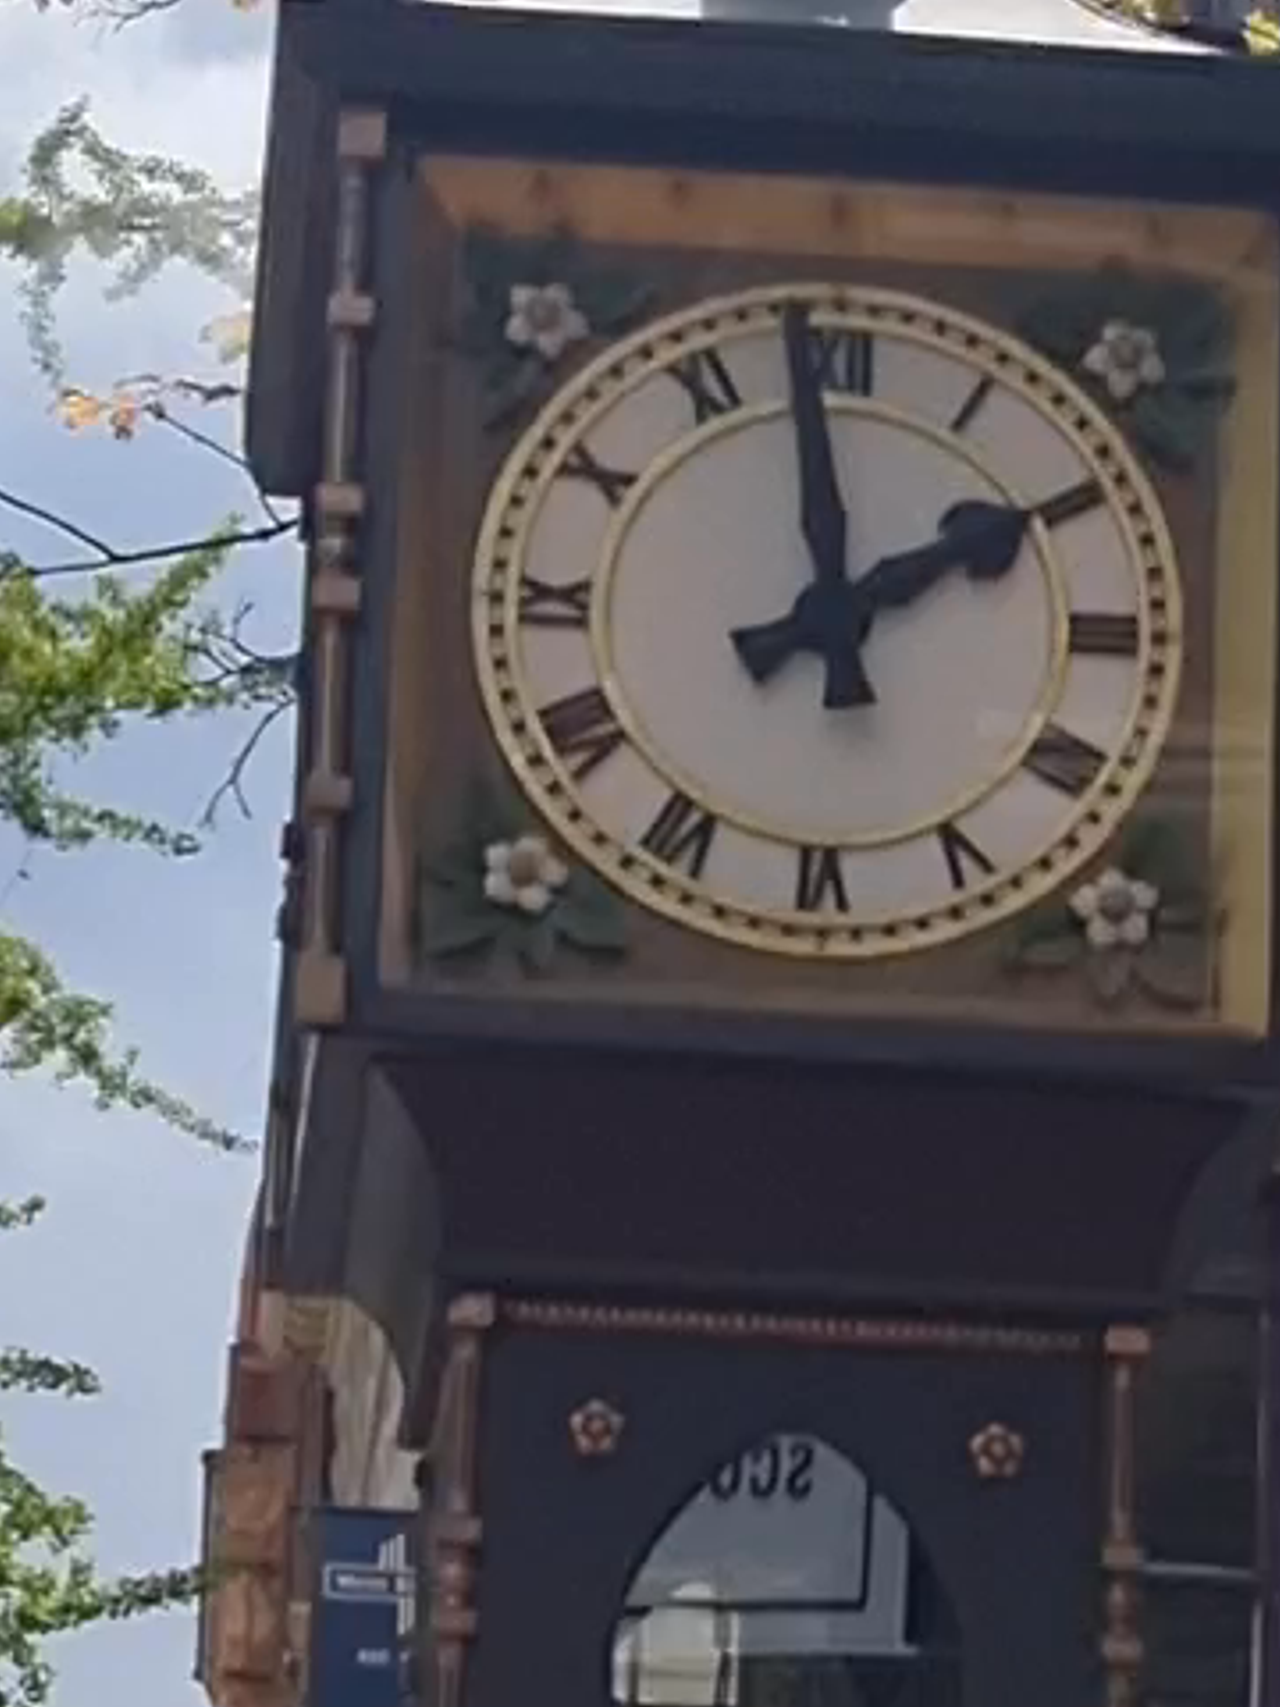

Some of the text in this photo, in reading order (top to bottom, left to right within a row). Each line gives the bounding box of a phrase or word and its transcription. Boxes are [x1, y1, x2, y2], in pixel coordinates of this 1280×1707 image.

[662, 347, 740, 424] XI
[555, 439, 638, 507] X
[517, 574, 591, 630] IX
[1066, 612, 1136, 654] III
[534, 687, 623, 783] VIII
[636, 790, 716, 879] VII
[936, 822, 997, 889] V
[794, 846, 848, 914] VI
